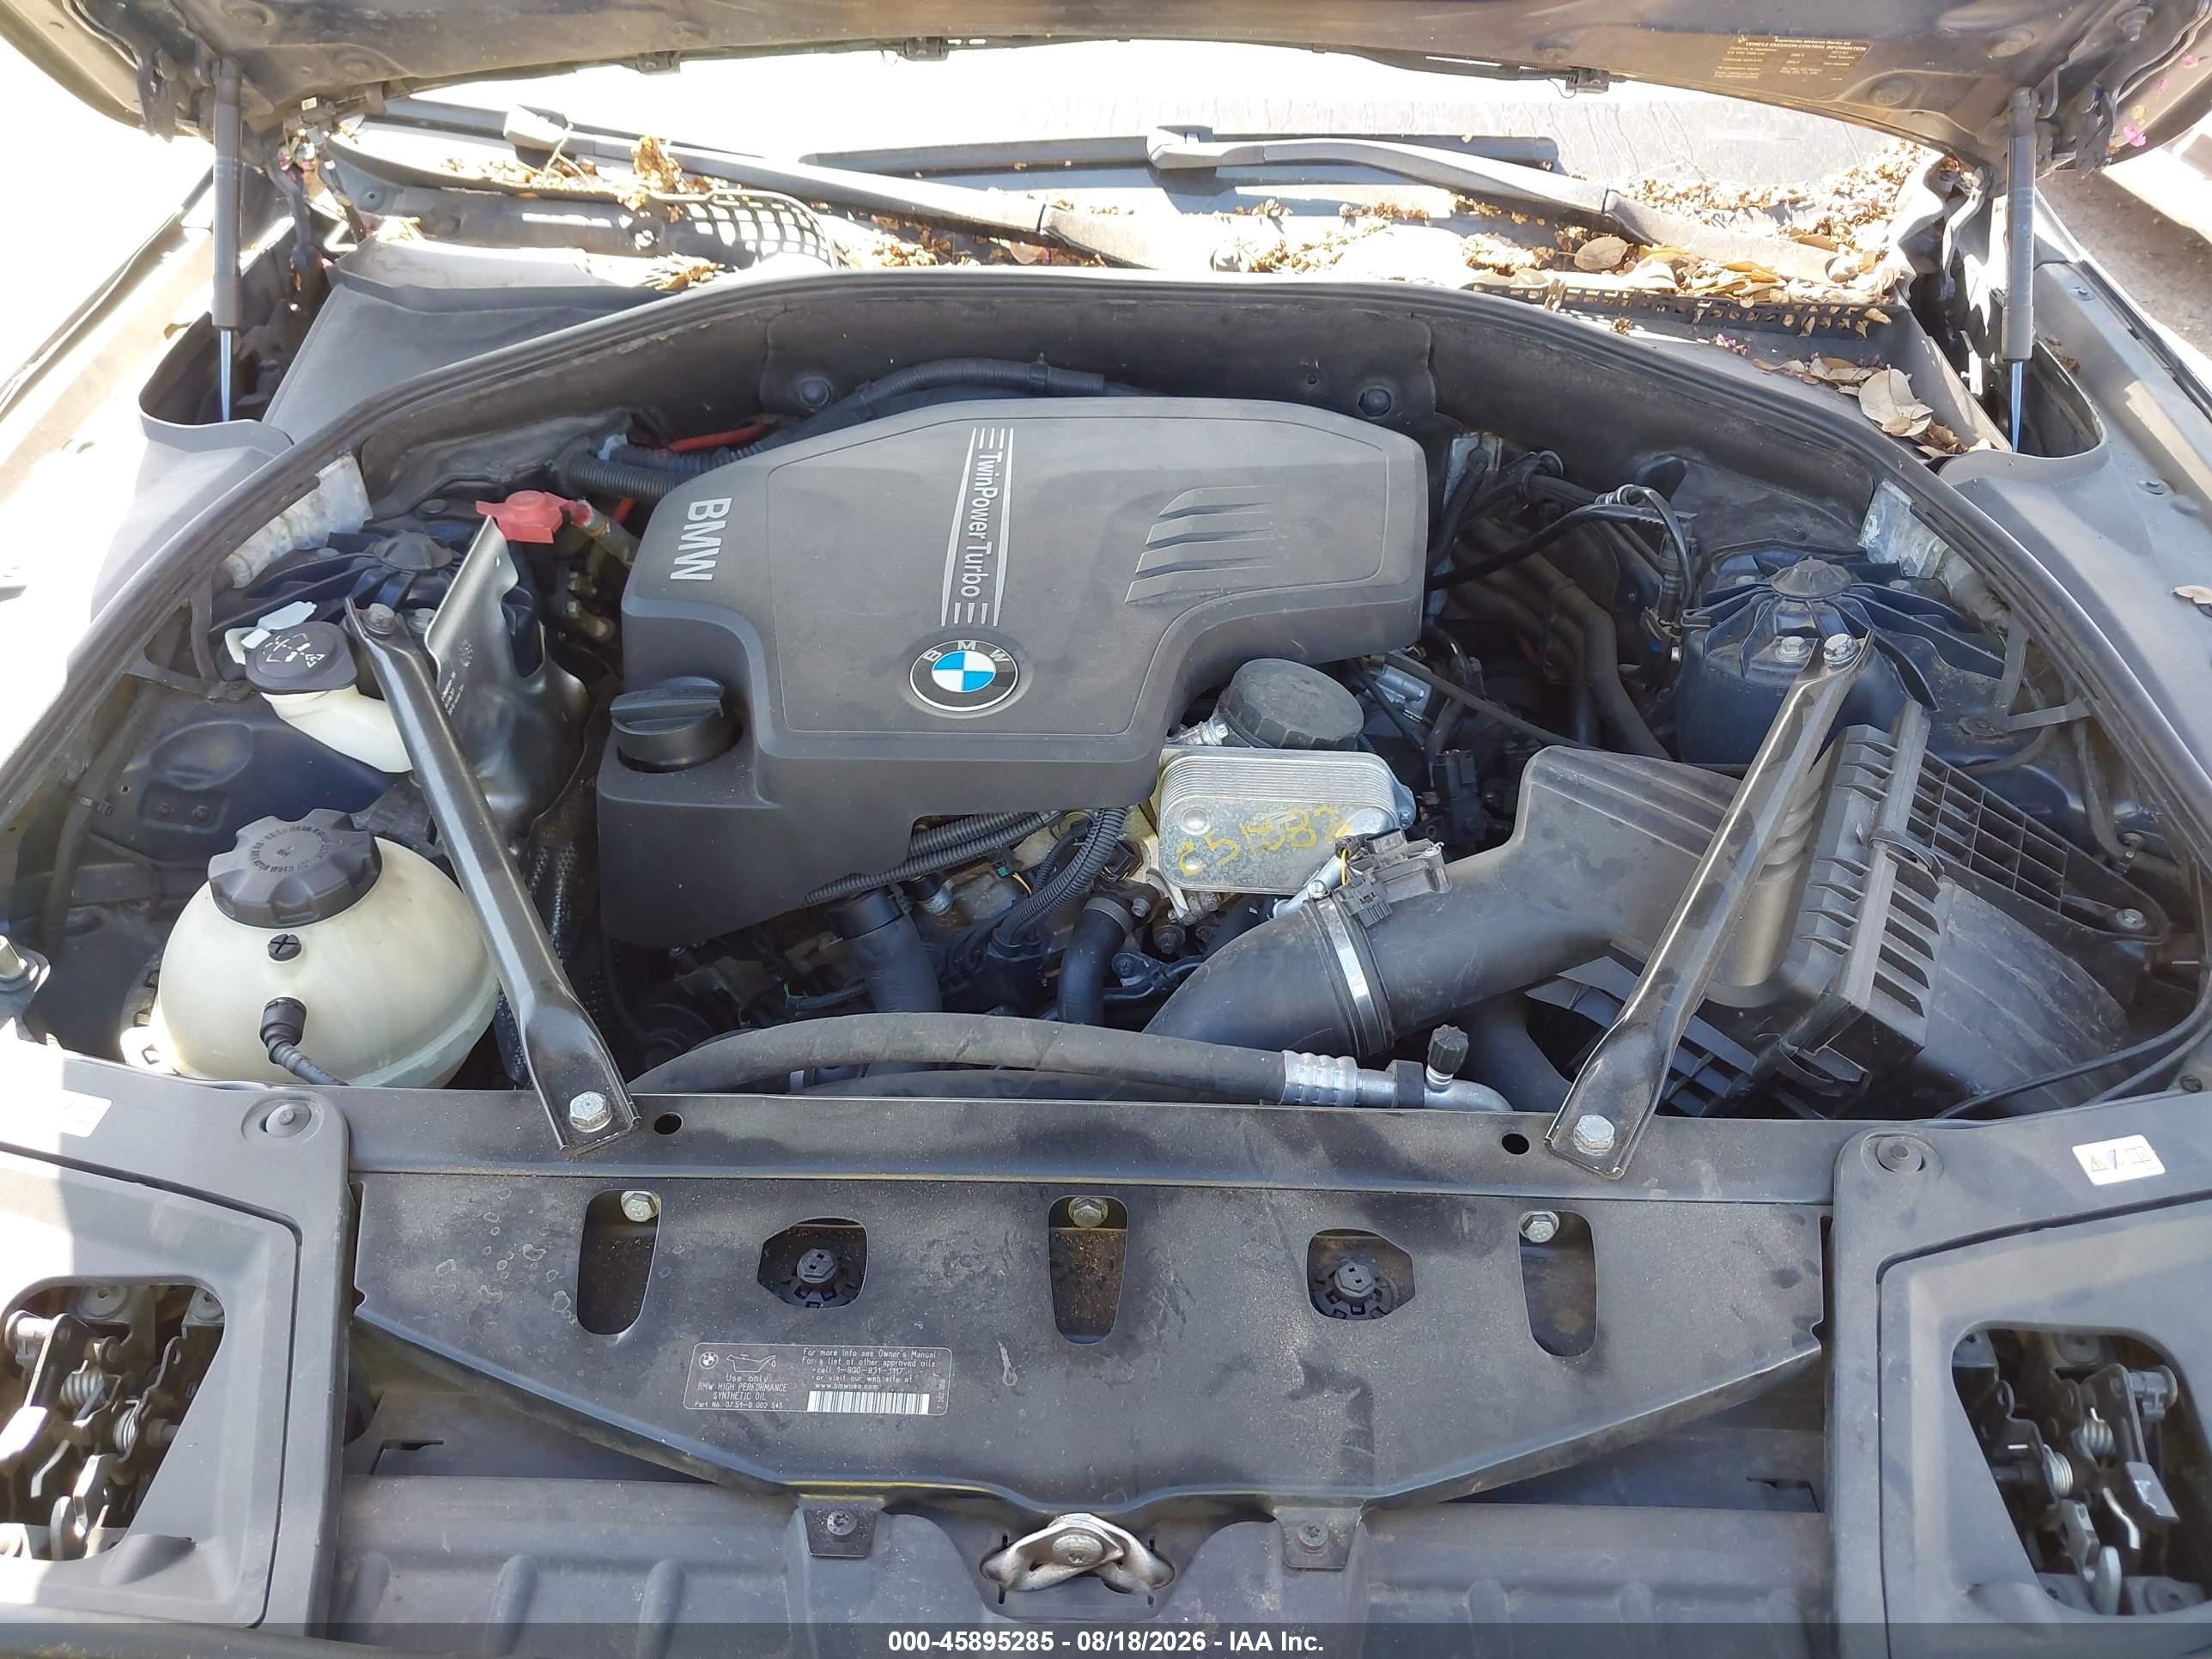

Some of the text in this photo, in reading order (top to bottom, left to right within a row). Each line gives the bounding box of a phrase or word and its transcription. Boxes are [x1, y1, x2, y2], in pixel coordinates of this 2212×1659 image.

[961, 452, 1002, 598] TwinPower Turbo
[671, 498, 732, 580] BMW
[803, 1347, 816, 1357] For
[911, 1350, 936, 1358] Manual
[802, 1356, 814, 1365] For
[828, 1357, 841, 1365] list
[846, 1357, 854, 1365] of
[859, 1357, 878, 1366] other
[883, 1359, 916, 1368] approved
[921, 1359, 935, 1368] oils
[817, 1365, 831, 1374] call
[726, 1374, 769, 1383] Use only
[904, 1374, 913, 1382] at
[697, 1382, 787, 1392] BMW HIGH PERFORMANCE
[713, 1391, 767, 1401] SYNTHETIC OIL
